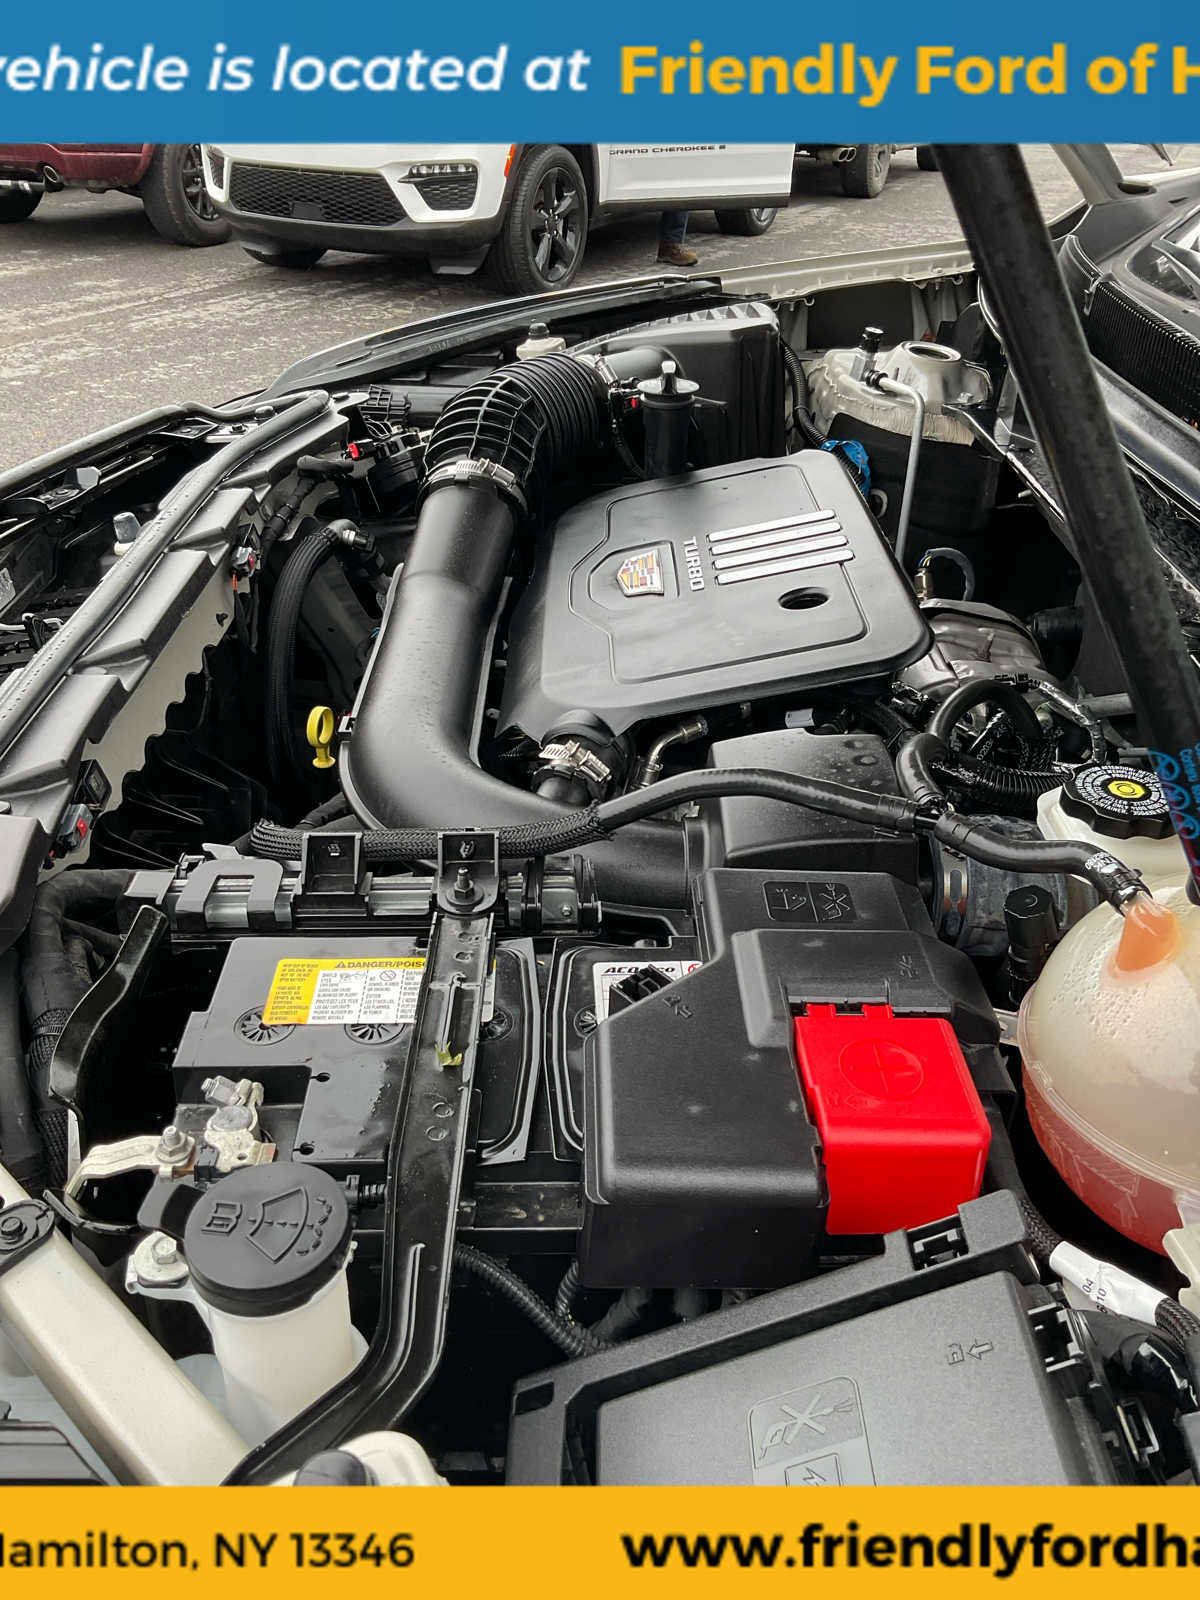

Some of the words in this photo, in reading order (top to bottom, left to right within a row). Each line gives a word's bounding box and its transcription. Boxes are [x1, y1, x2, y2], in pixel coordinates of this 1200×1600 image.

[609, 148, 649, 156] GRAND
[652, 145, 715, 153] CHEROKEE
[684, 536, 705, 592] TURBO
[1082, 1277, 1094, 1293] 04
